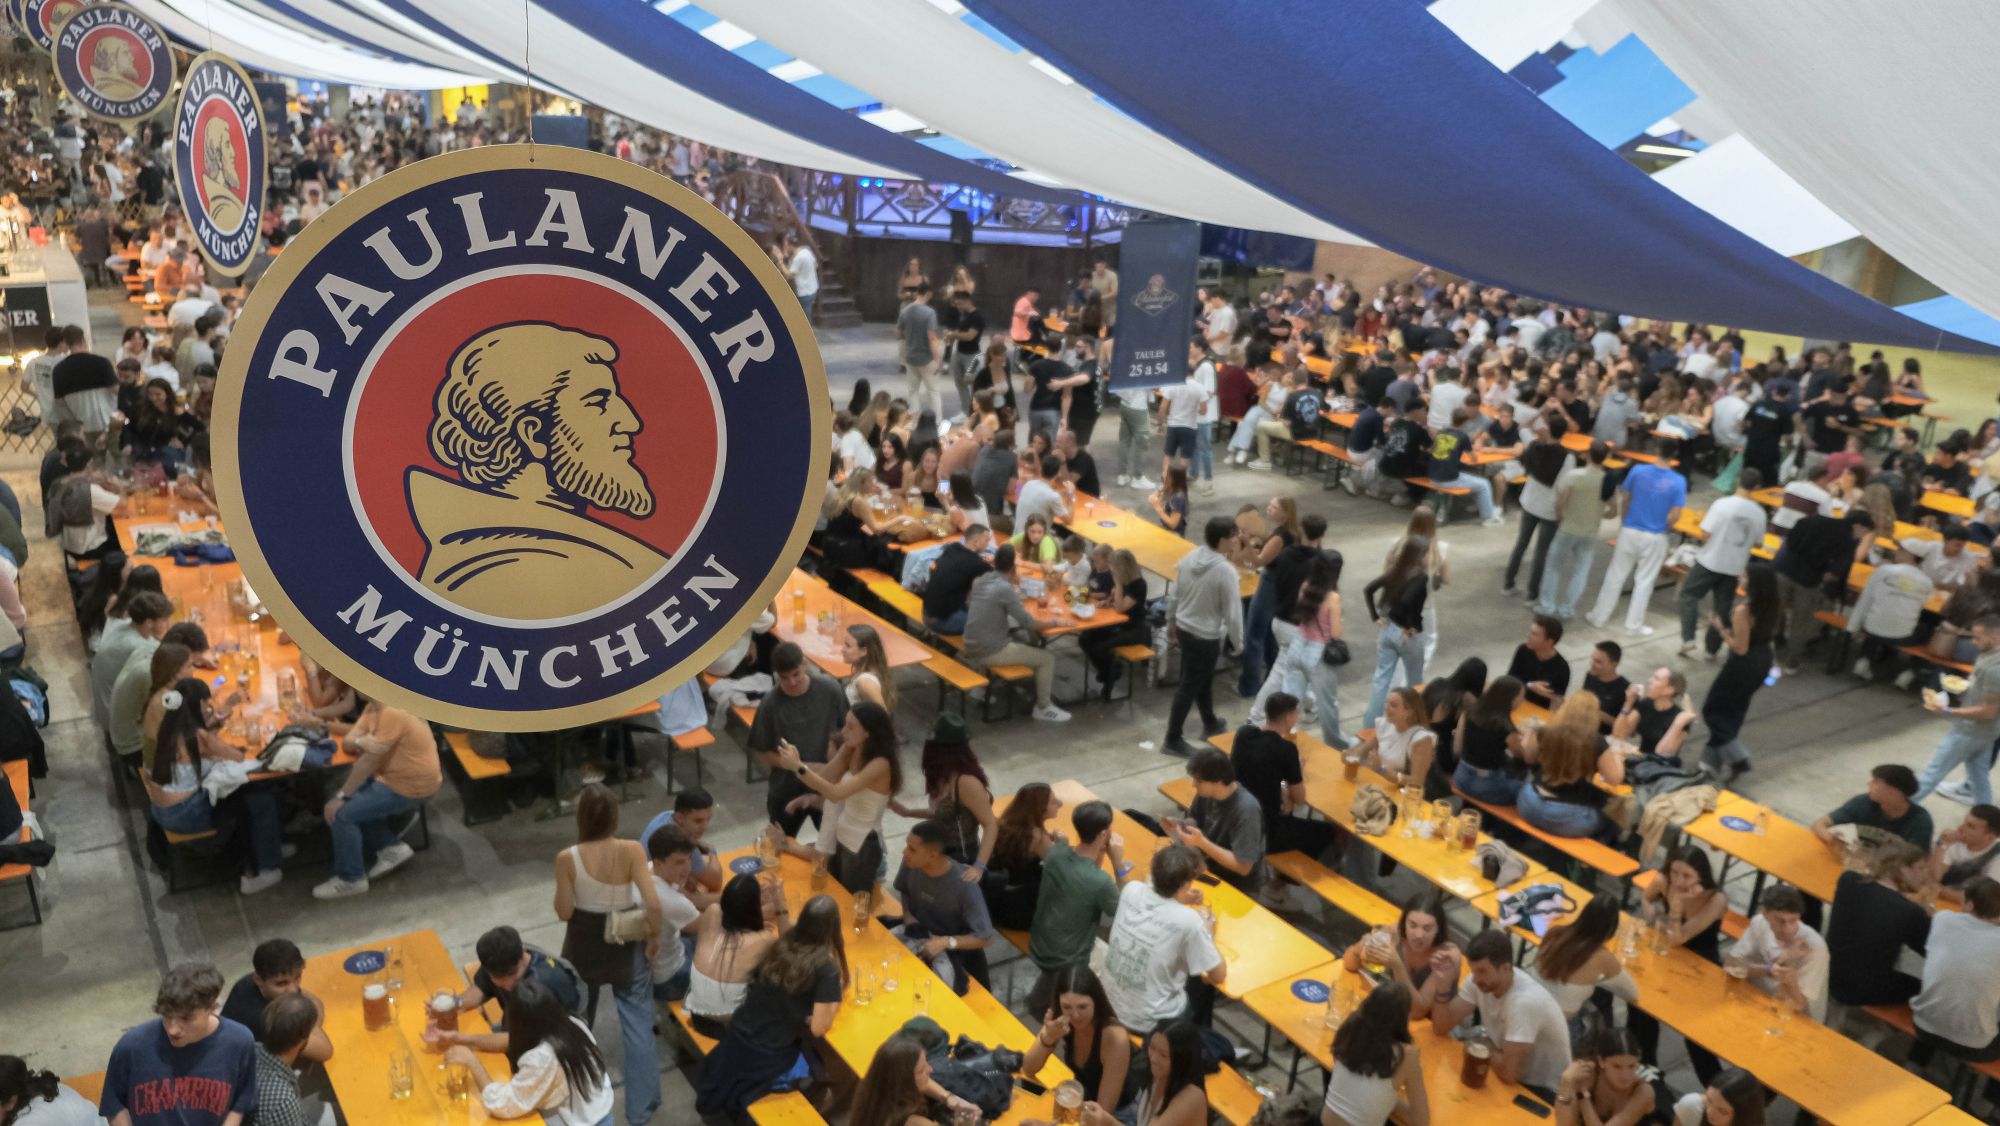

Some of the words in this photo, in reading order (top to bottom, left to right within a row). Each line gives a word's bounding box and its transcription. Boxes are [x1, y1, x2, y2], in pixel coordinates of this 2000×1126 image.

[61, 8, 163, 51] PAULANER
[178, 65, 258, 147] PAULANER
[199, 203, 258, 261] MÜNCHEN
[268, 187, 776, 397] PAULANER
[1129, 364, 1143, 377] 25
[1144, 366, 1152, 376] a
[1154, 362, 1168, 374] 54
[1134, 350, 1166, 360] TAULES
[337, 553, 741, 691] MÜNCHEN
